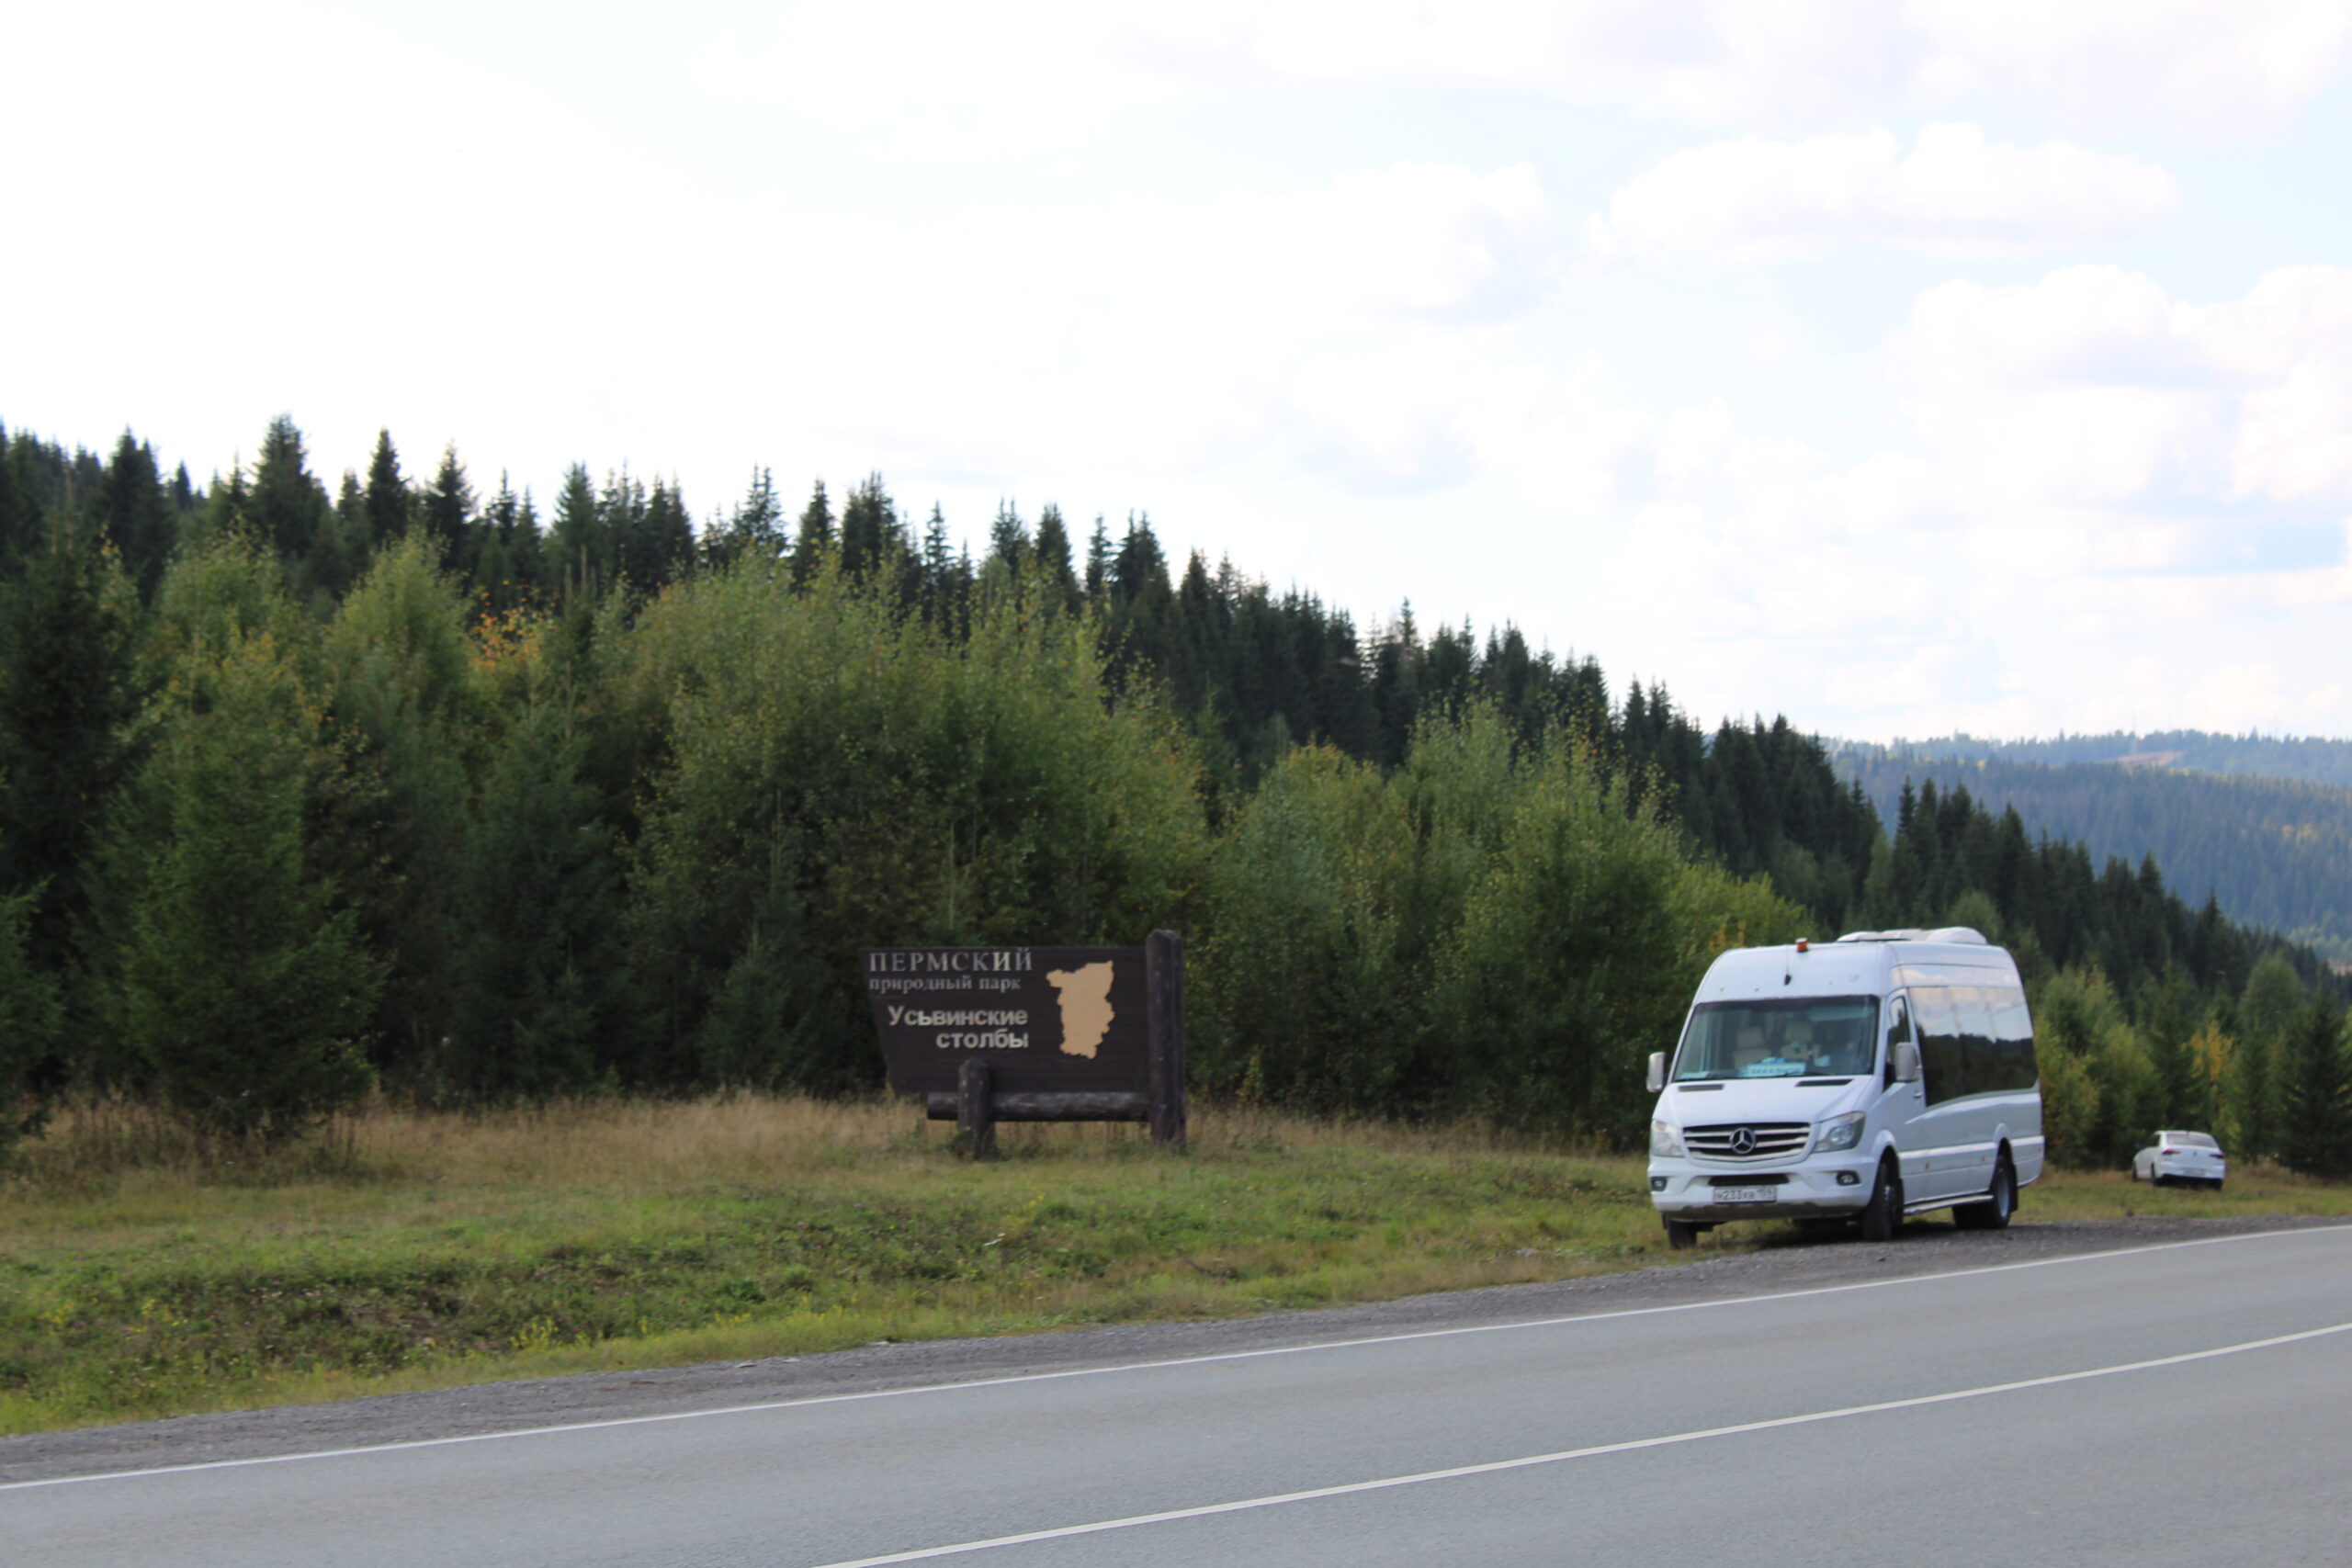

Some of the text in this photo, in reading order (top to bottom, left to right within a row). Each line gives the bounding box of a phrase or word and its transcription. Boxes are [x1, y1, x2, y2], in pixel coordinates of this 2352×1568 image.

[869, 947, 1032, 971] ПЕРМСКИЙ
[869, 975, 1022, 994] природный парк
[888, 1005, 1028, 1026] Усьвинские
[936, 1029, 1029, 1049] столбы
